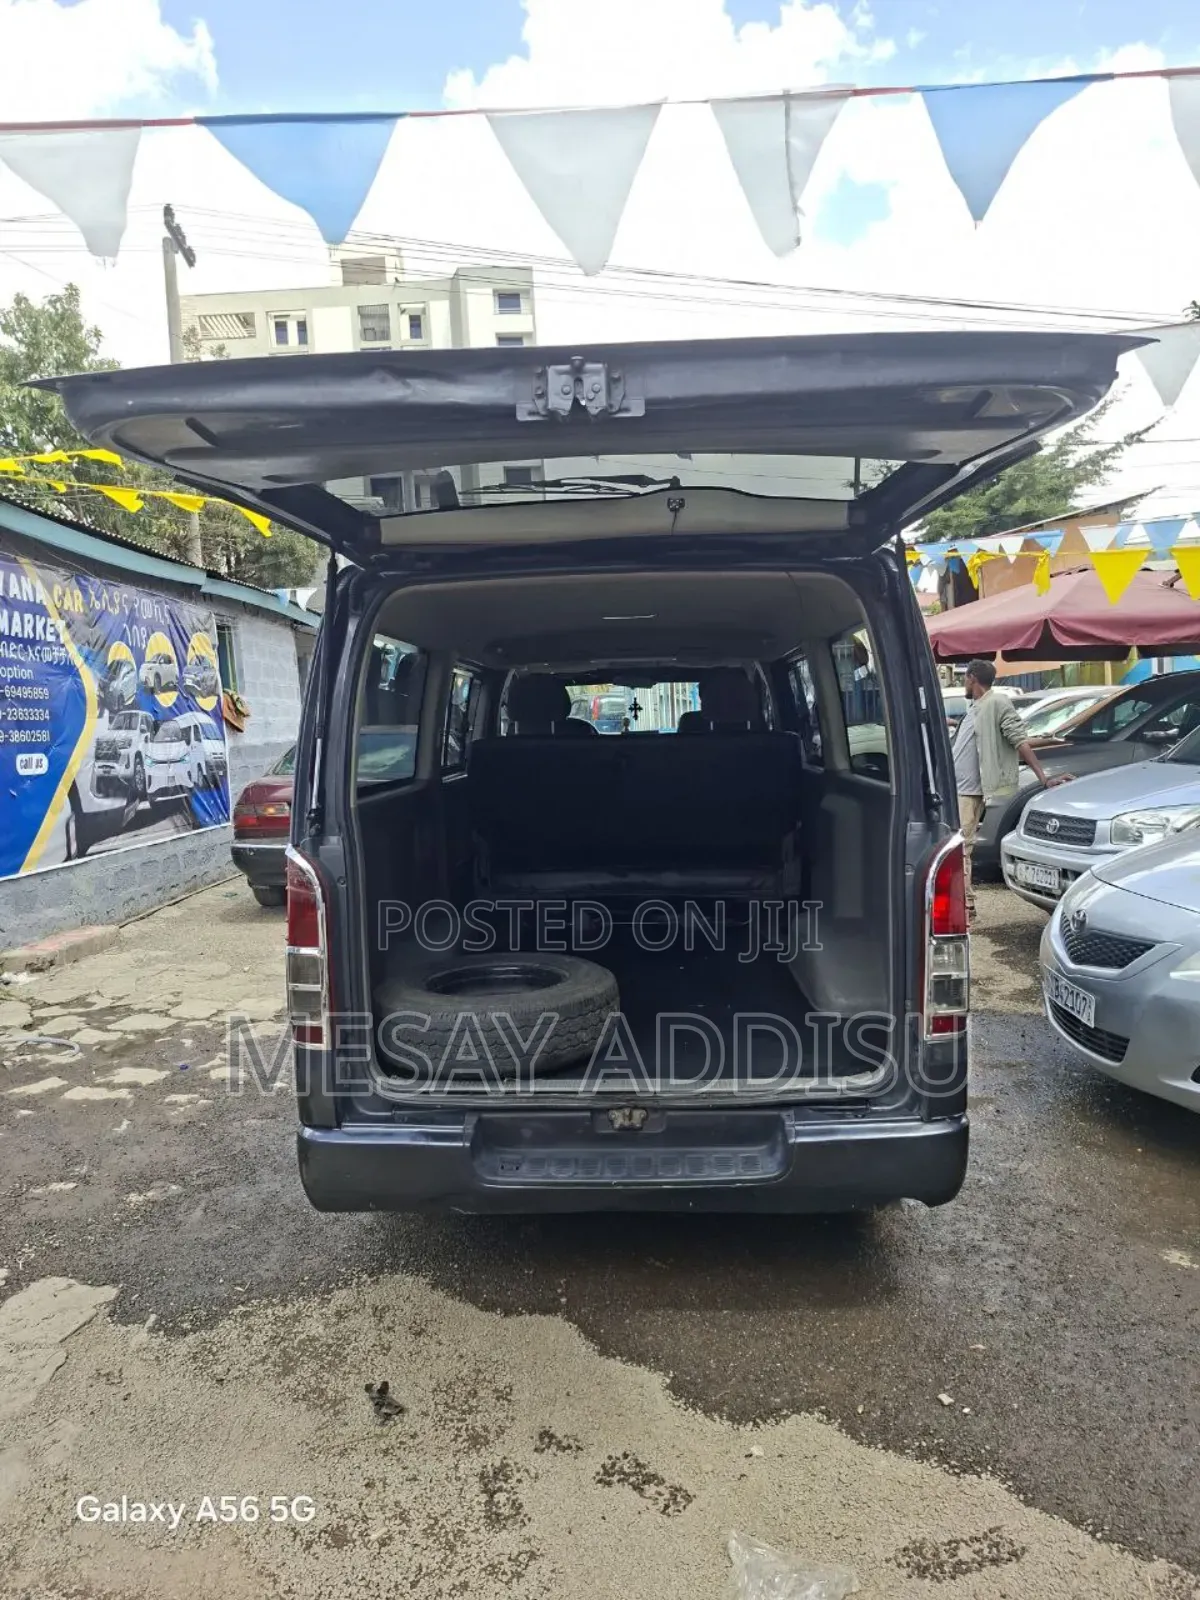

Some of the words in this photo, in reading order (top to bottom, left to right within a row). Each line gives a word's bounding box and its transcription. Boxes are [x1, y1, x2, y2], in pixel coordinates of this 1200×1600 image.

[53, 583, 84, 613] CAR
[0, 608, 66, 644] MARKET
[0, 664, 34, 682] option
[20, 755, 34, 770] call
[35, 757, 44, 769] us
